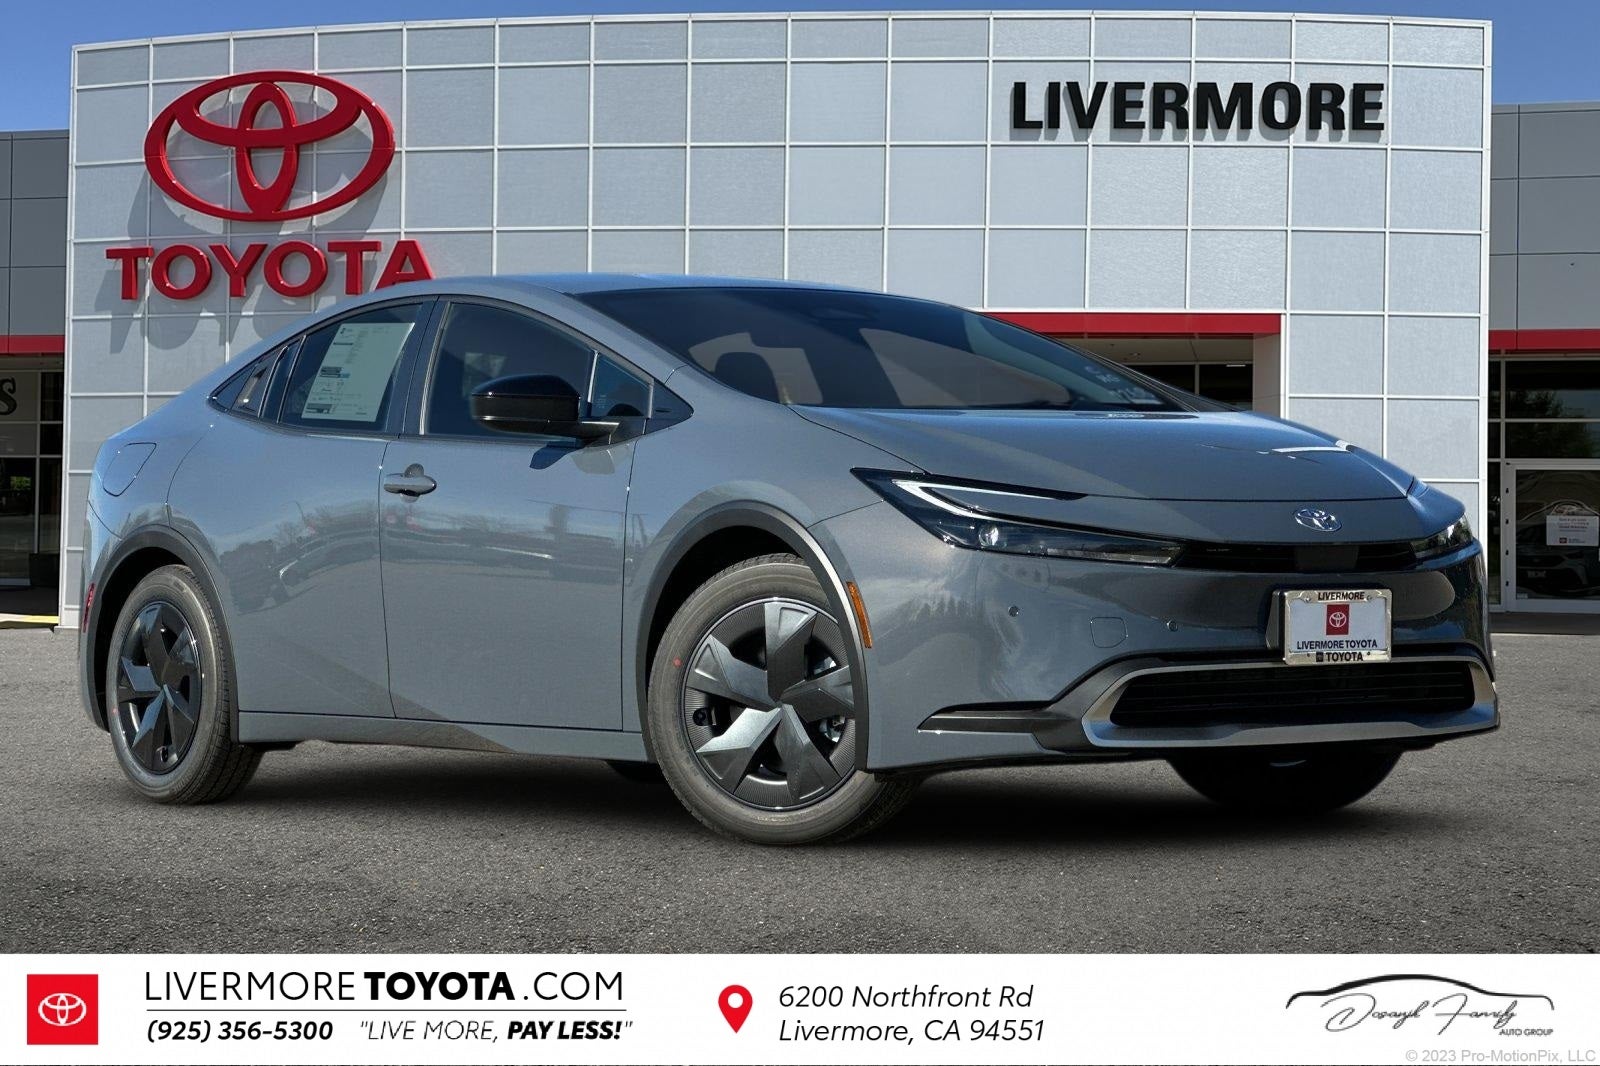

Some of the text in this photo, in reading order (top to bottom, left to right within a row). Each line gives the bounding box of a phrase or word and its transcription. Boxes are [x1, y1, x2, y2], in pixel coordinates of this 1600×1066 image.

[1013, 81, 1384, 131] LIVERMORE
[105, 240, 433, 300] TOYOTA
[1317, 592, 1365, 601] LIVERMORE
[1296, 639, 1378, 650] LIVERMORE TOYOTA
[1326, 651, 1364, 662] TOYOTA
